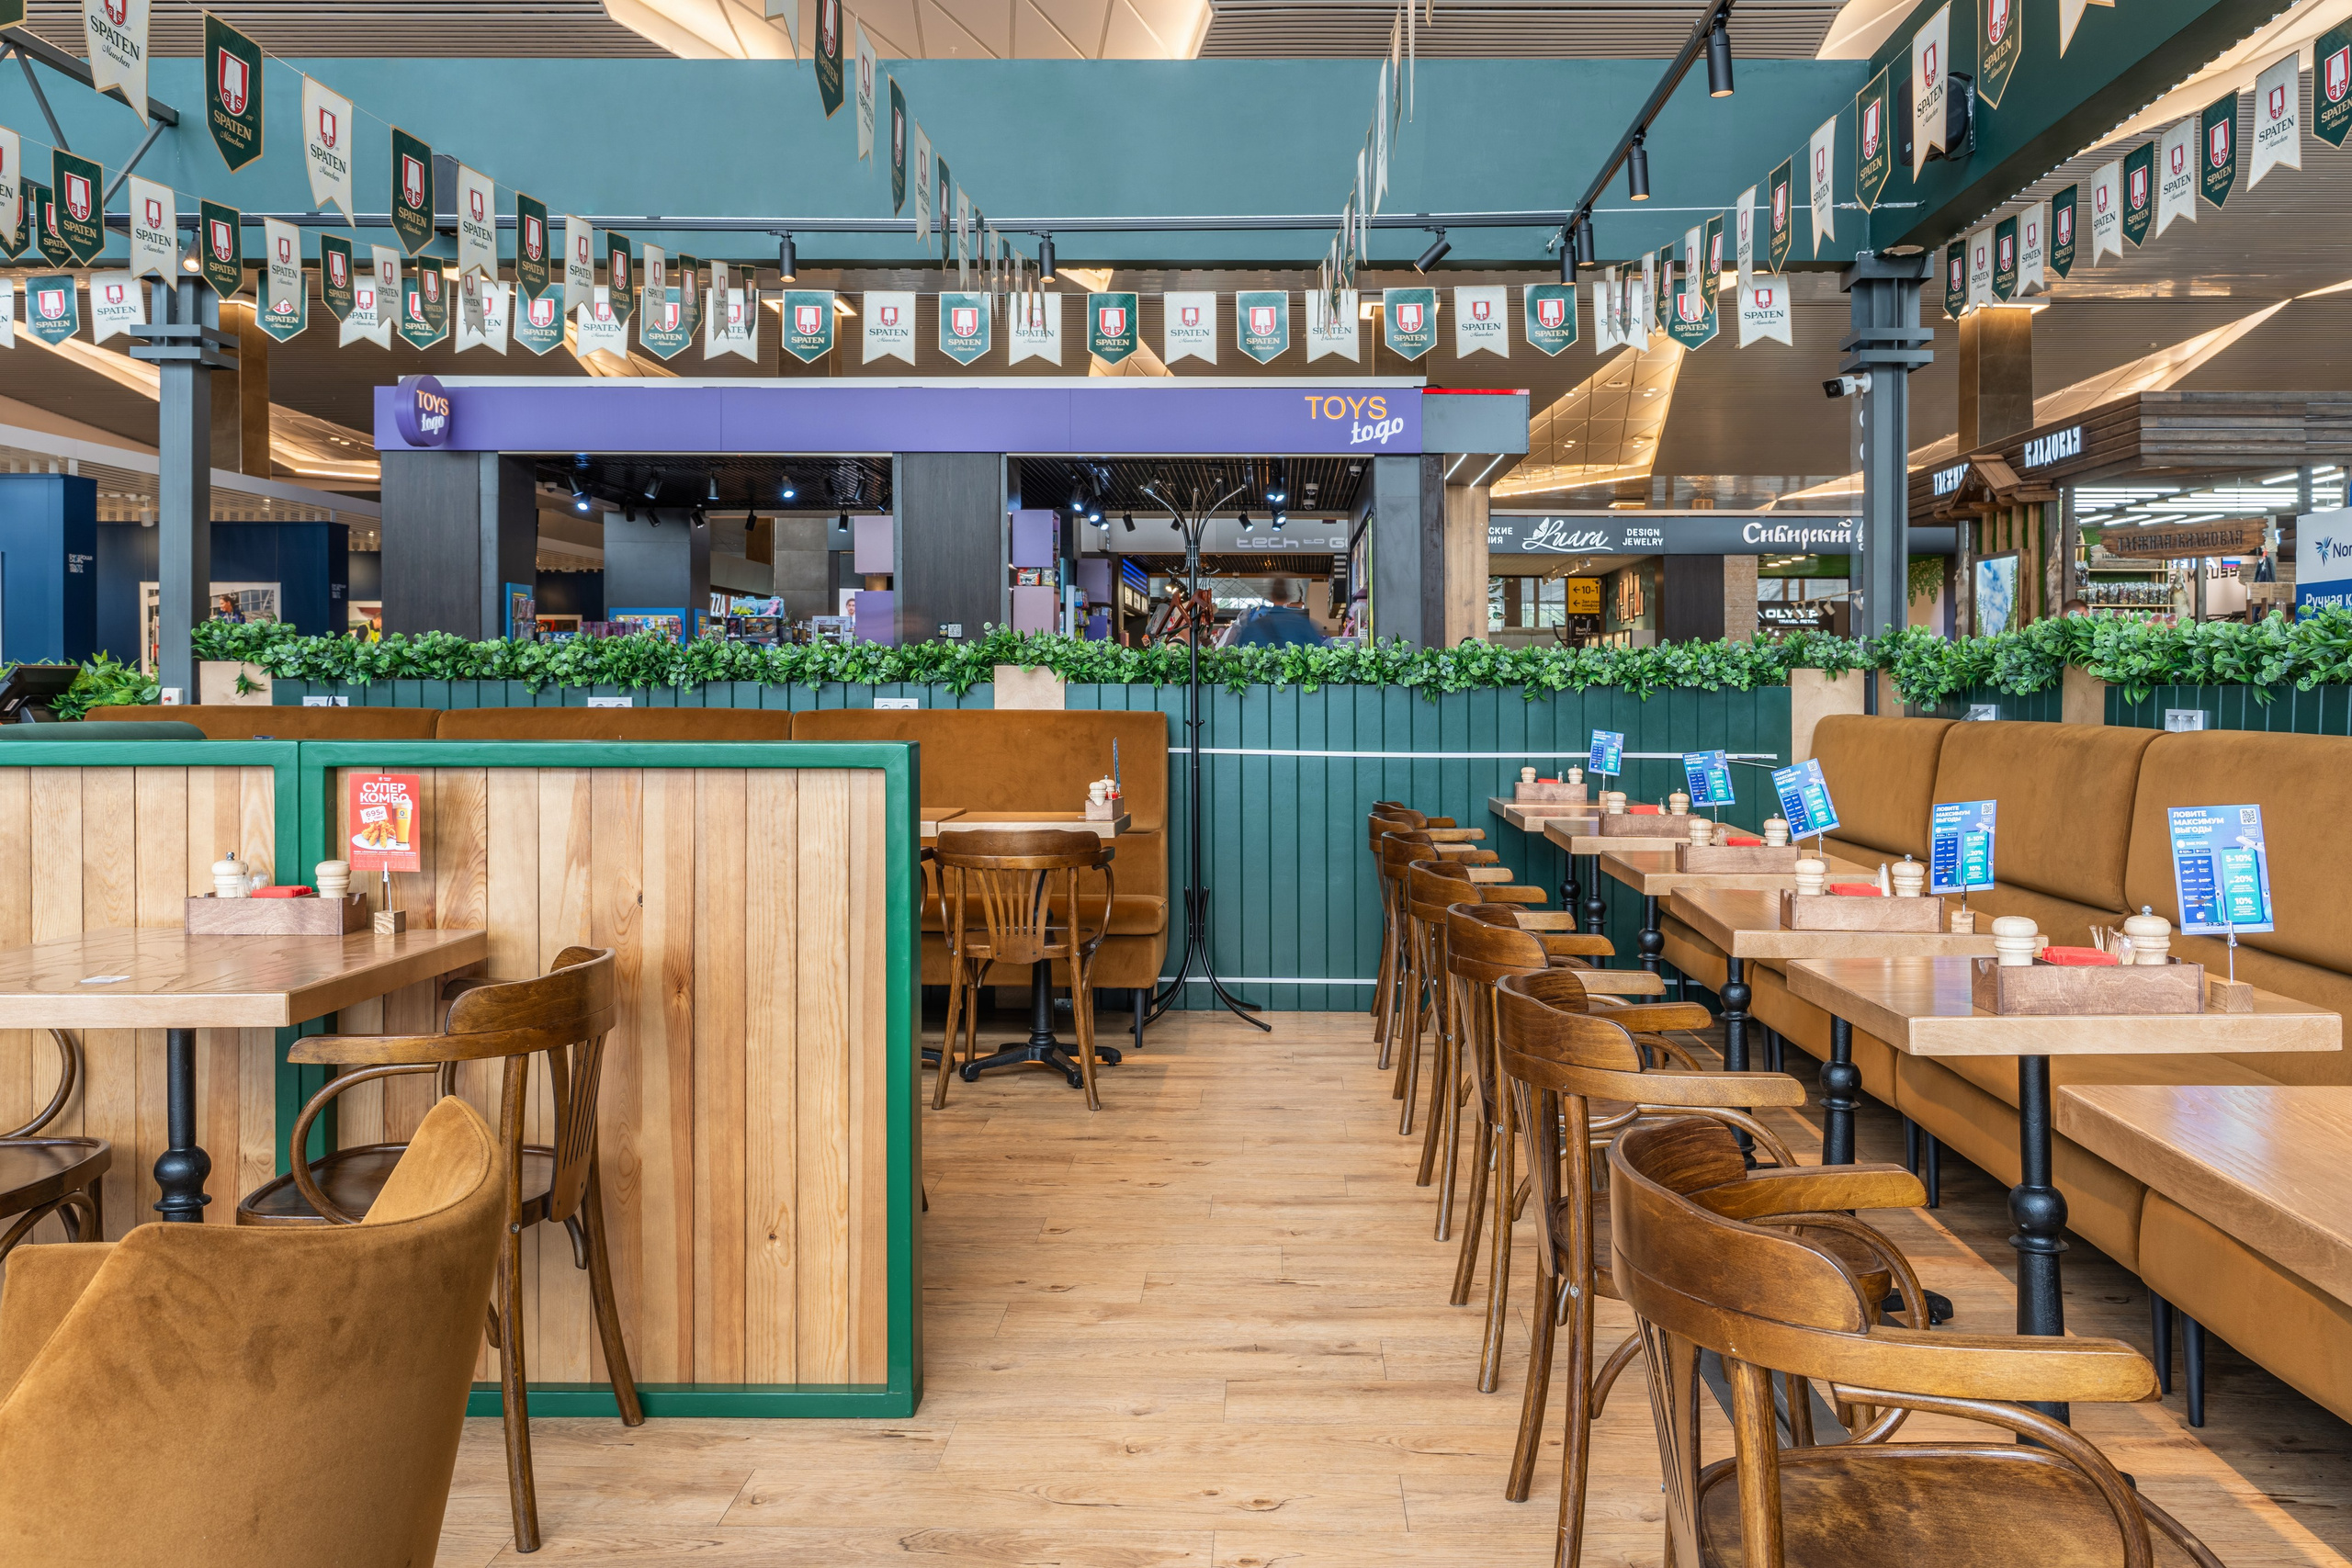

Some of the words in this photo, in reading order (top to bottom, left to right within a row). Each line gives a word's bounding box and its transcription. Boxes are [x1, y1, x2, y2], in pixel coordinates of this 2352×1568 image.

[90, 15, 140, 61] SPATEN
[1984, 35, 2012, 73] SPATEN
[819, 50, 838, 85] SPATEN
[224, 92, 230, 101] G
[236, 99, 242, 108] S
[1917, 81, 1943, 118] SPATEN
[2321, 96, 2352, 123] SPATEN
[214, 109, 252, 141] SPATEN
[2258, 115, 2294, 143] SPATEN
[311, 143, 345, 175] SPATEN
[1860, 155, 1883, 181] SPATEN
[2207, 164, 2233, 186] SPATEN
[2164, 173, 2191, 195] SPATEN
[1814, 183, 1829, 206] SPATEN
[398, 207, 426, 229] SPATEN
[2094, 211, 2116, 230] SPATEN
[2128, 207, 2149, 225] SPATEN
[63, 220, 96, 238] SPATEN
[463, 221, 492, 243] SPATEN
[43, 237, 66, 248] SPATE
[136, 228, 171, 247] SPATEN
[1771, 231, 1786, 248] SPATEN
[2022, 247, 2041, 264] SPATEN
[2054, 246, 2073, 259] SPATEN
[209, 263, 236, 276] SPATEN
[272, 264, 297, 279] SPATEN
[522, 261, 544, 275] SPATEN
[570, 265, 592, 280] SPATEN
[1972, 270, 1989, 284] SPATEN
[1996, 272, 2015, 284] SPATEN
[329, 289, 350, 299] SPATEN
[379, 287, 399, 298] SPATEN
[612, 290, 629, 302] SPATEN
[1949, 291, 1964, 302] SPATEN
[97, 306, 136, 316] SPATEN
[424, 304, 443, 312] SPATEN
[1744, 310, 1784, 319] SPATEN
[36, 321, 70, 329] SPATEN
[265, 315, 299, 323] SPATEN
[1462, 322, 1501, 331] SPATEN
[523, 328, 557, 336] SPATEN
[583, 323, 622, 332] SPATEN
[1675, 323, 1709, 332] SPATEN
[649, 333, 682, 341] SPATEN
[948, 338, 981, 346] SPATEN
[1095, 338, 1129, 346] SPATEN
[416, 389, 449, 416] TOYS
[1305, 396, 1387, 419] TOYS
[421, 413, 445, 434] togo
[1351, 418, 1404, 445] togo
[2024, 426, 2081, 468] КЛАДОВАЯ
[1522, 519, 1613, 552] Luara
[1626, 528, 1659, 536] DESIGN
[1743, 519, 1852, 550] Сибирский
[1623, 537, 1663, 546] JEWELRY
[2118, 534, 2171, 551] ТАЕЖНАЯ
[2177, 529, 2243, 547] КЛАДОВАЯ
[362, 783, 406, 793] СУПЕР
[360, 793, 409, 803] КОМБО
[2174, 818, 2224, 826] МАКСИМУМ
[2175, 826, 2212, 834] ВЫГОДЫ
